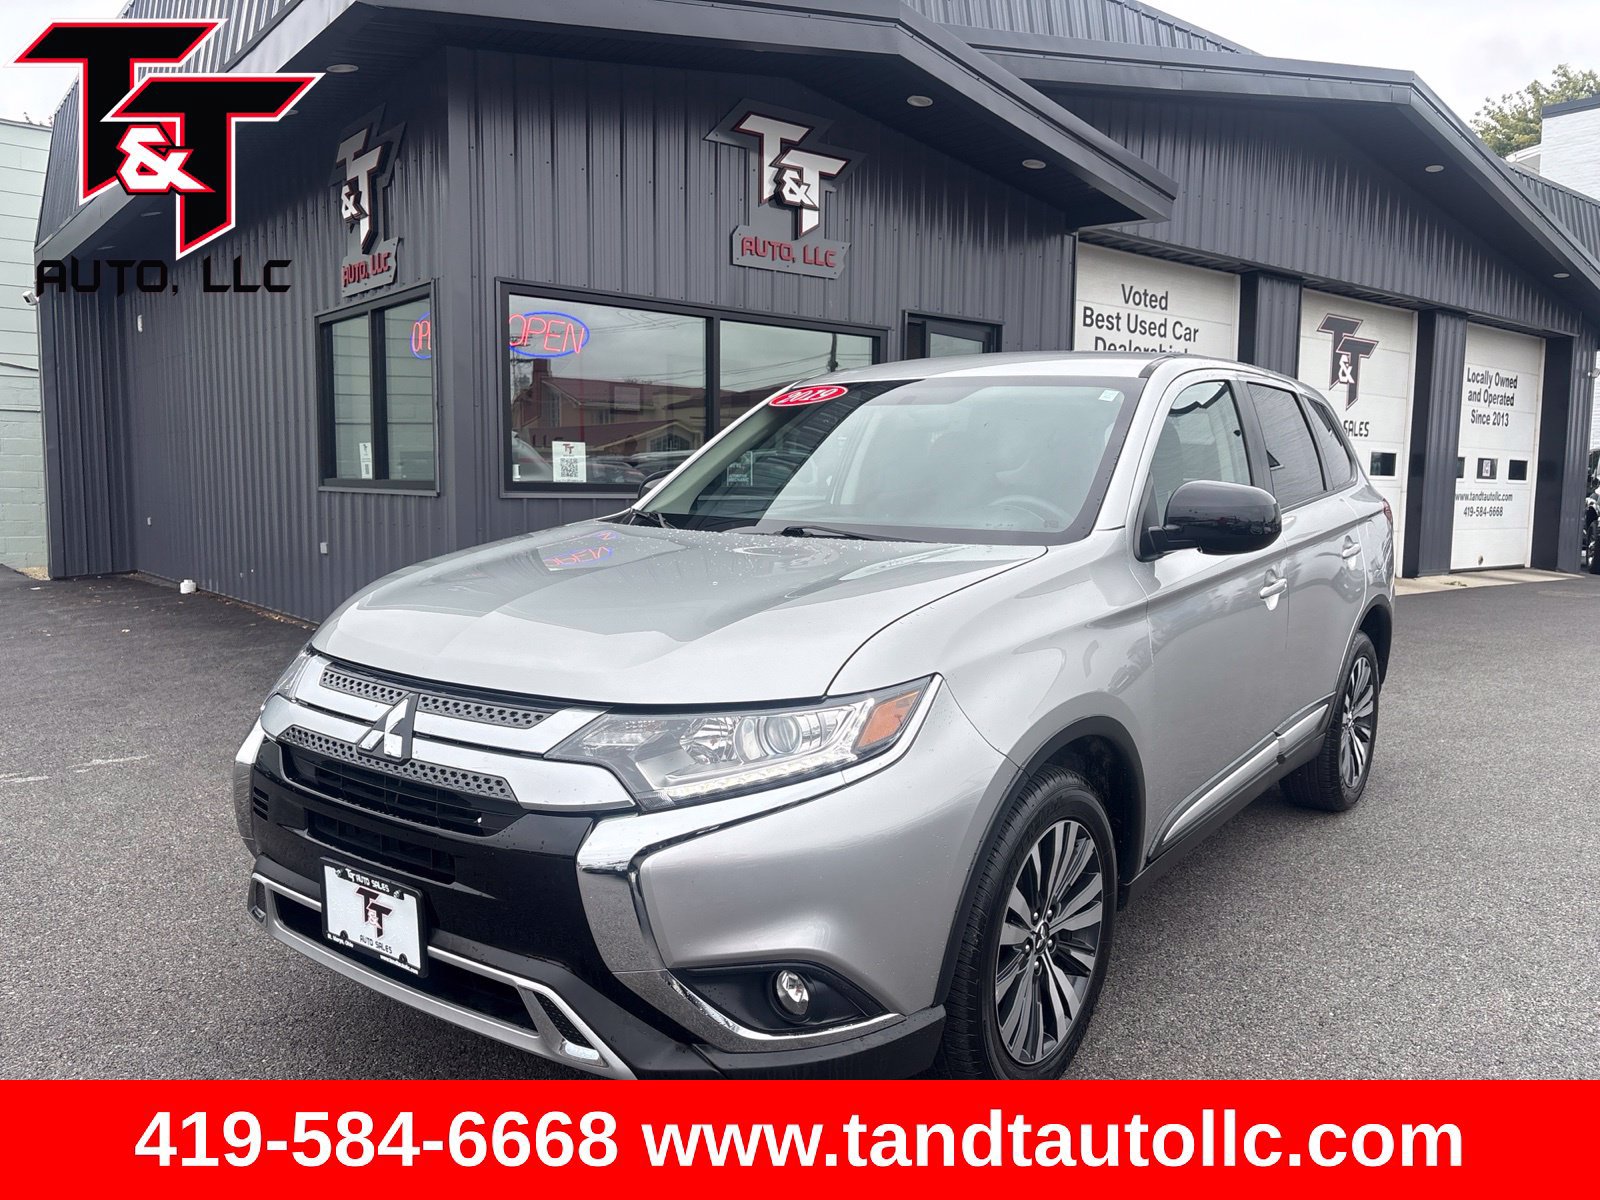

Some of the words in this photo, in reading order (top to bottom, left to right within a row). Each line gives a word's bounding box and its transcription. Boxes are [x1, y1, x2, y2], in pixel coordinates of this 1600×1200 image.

[730, 111, 851, 237] T&T
[336, 128, 384, 252] T&T
[742, 236, 796, 263] AUTO,
[803, 243, 837, 268] LLC
[342, 261, 368, 287] AUTO,
[370, 251, 391, 276] LLC
[1121, 284, 1168, 311] Voted
[509, 313, 585, 353] OPEN
[1082, 305, 1121, 332] Best
[1127, 312, 1167, 338] Used
[1172, 320, 1199, 342] Car
[1316, 313, 1379, 411] T&T
[1467, 367, 1493, 389] Locally
[1494, 371, 1518, 389] Owned
[775, 388, 839, 404] 2019
[1468, 388, 1482, 402] and
[1483, 389, 1515, 407] Operated
[1343, 420, 1370, 437] SALES
[1471, 409, 1491, 425] Since
[1492, 411, 1509, 427] 2013
[1463, 506, 1503, 517] 419-584-6668
[360, 934, 374, 946] AUTO
[375, 940, 393, 954] SALES
